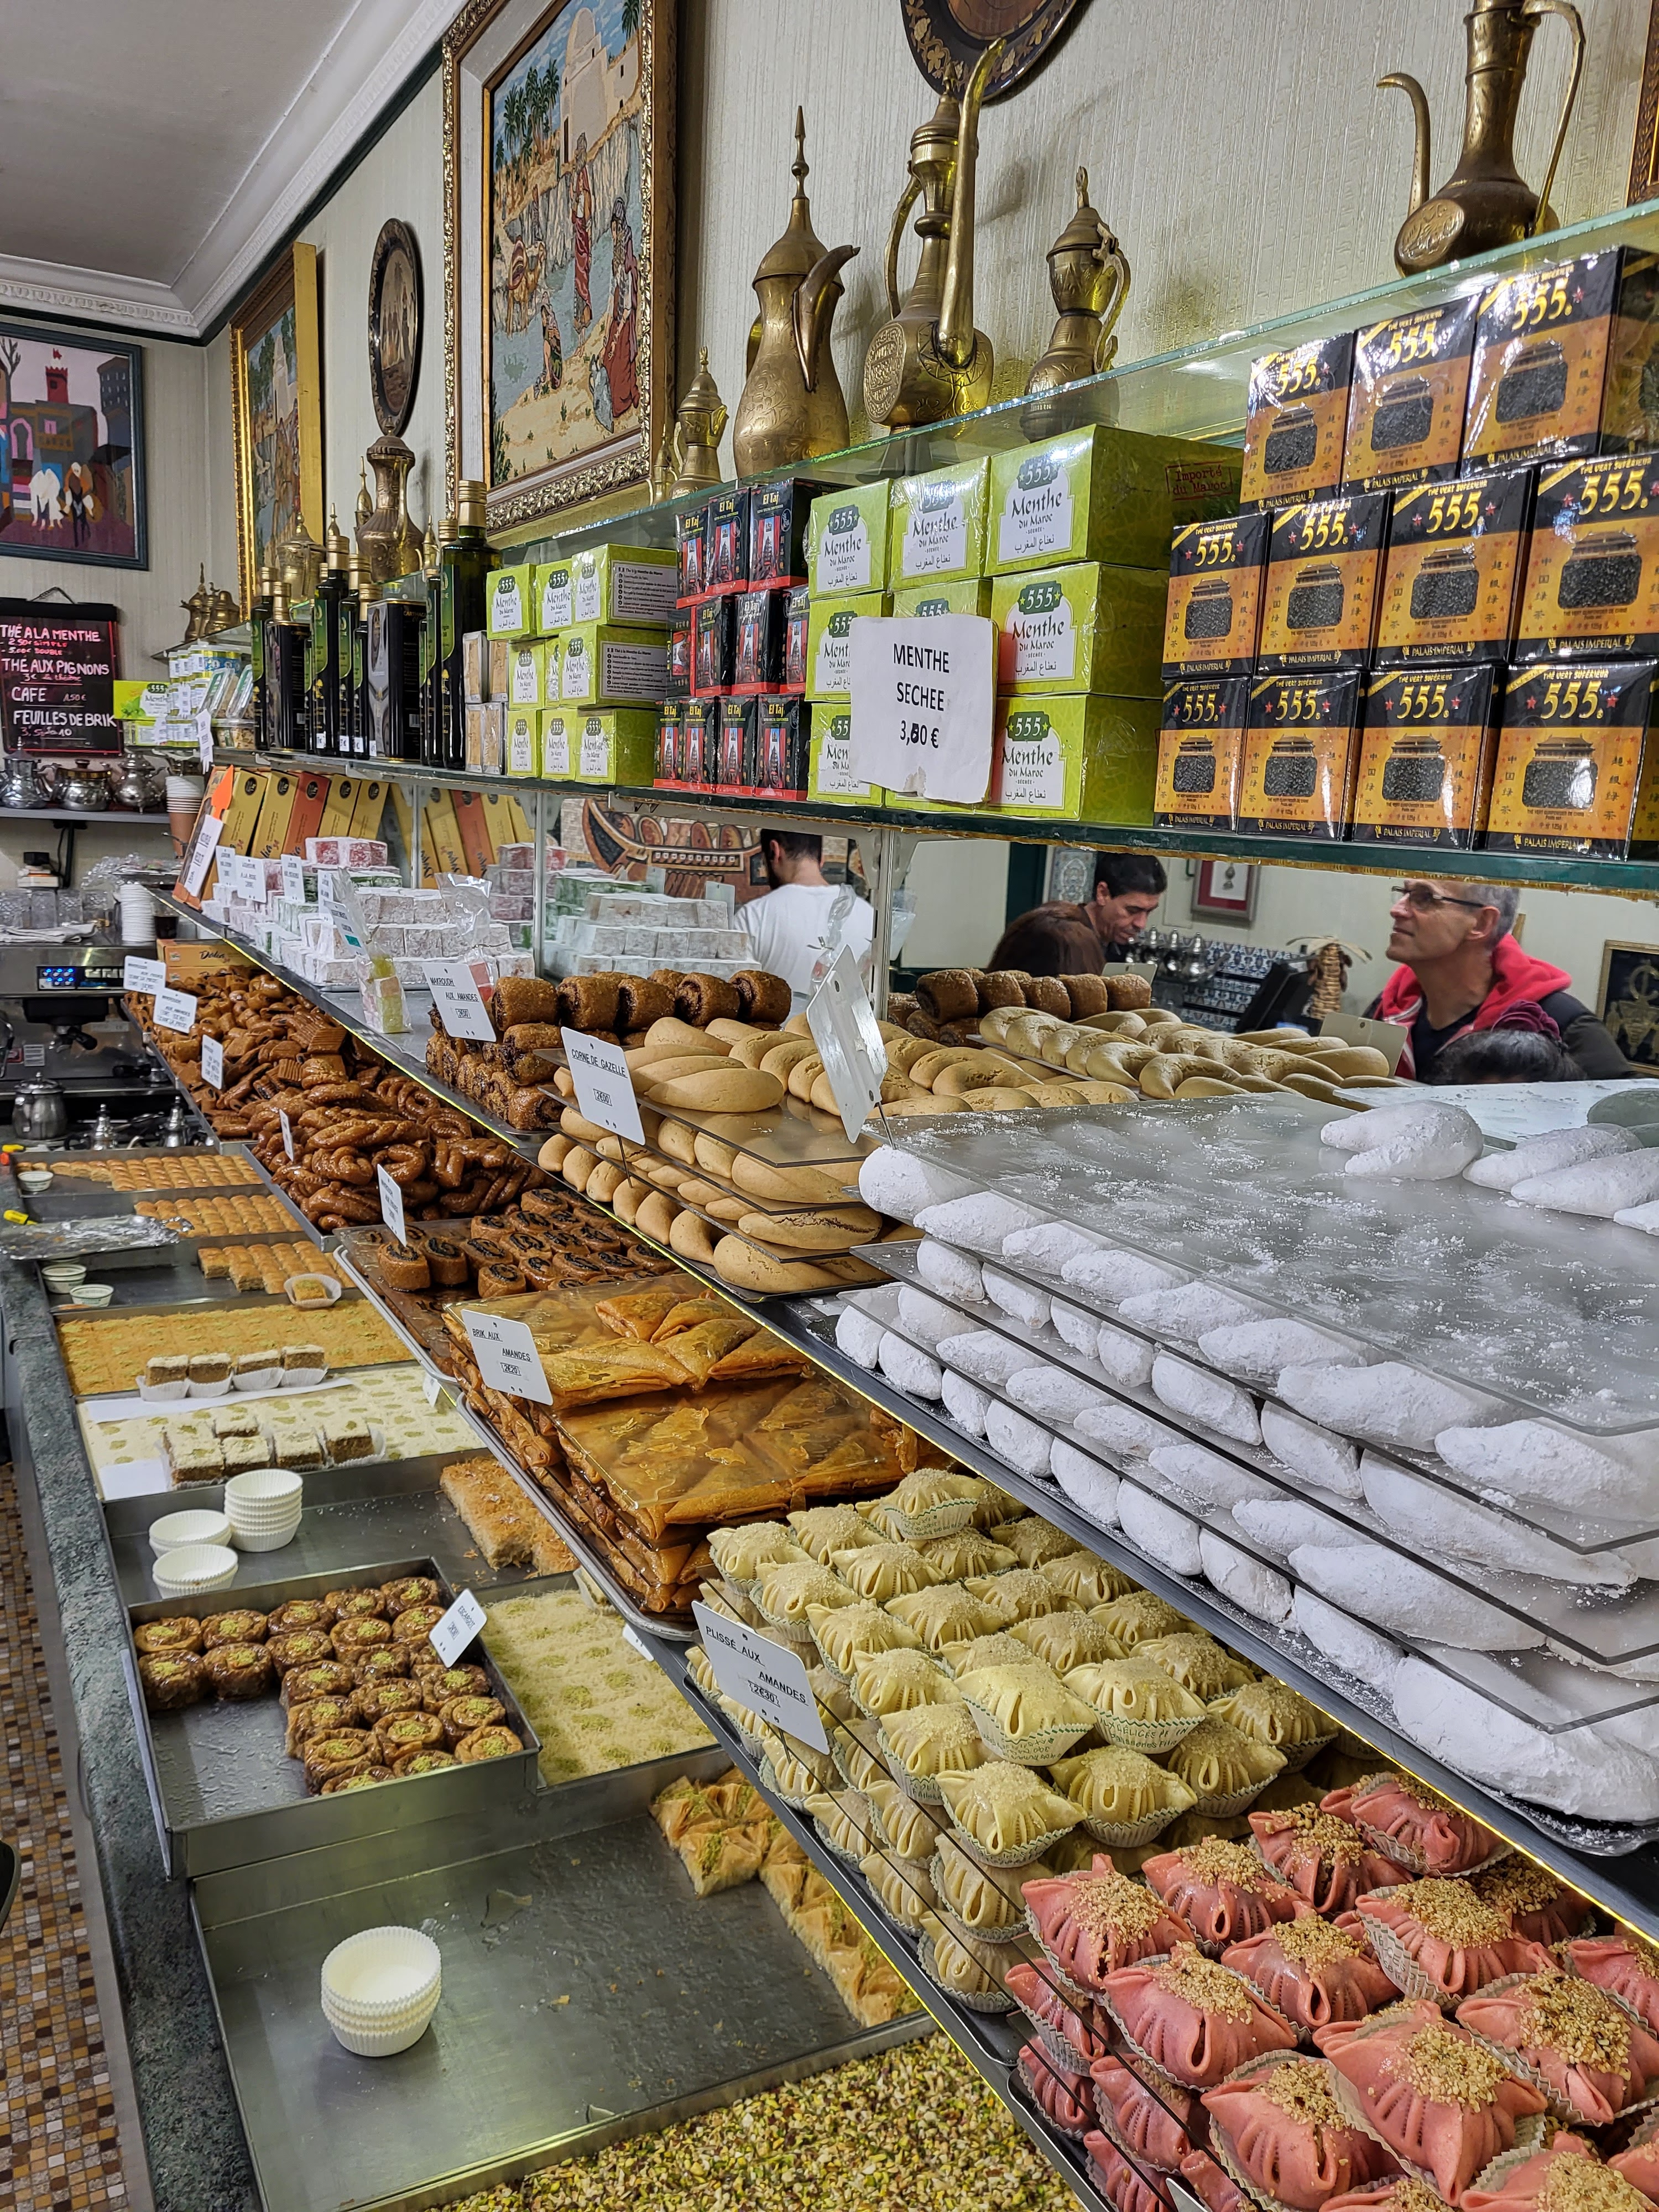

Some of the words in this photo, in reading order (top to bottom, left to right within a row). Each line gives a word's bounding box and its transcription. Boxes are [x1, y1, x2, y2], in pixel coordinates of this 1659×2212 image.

[1512, 277, 1568, 330] 555
[1390, 321, 1436, 365] 555
[1275, 355, 1318, 397] 555
[1025, 462, 1050, 485] 555
[1175, 465, 1222, 482] Importé
[1173, 484, 1187, 495] du
[1192, 481, 1226, 493] Maroc
[1579, 469, 1645, 515] 555
[719, 502, 724, 513] El
[726, 499, 734, 512] Taj
[763, 494, 769, 505] El
[770, 491, 779, 505] Taj
[1011, 487, 1062, 519] Menthe
[833, 510, 853, 530] 555
[1426, 490, 1482, 534] 555
[685, 518, 691, 529] El
[691, 515, 700, 529] Taj
[913, 512, 957, 538] Menthe
[1019, 520, 1027, 529] du
[1030, 514, 1052, 526] Maroc
[1300, 512, 1347, 550] 555
[825, 534, 862, 557] Menthe
[928, 536, 948, 546] Maroc
[1194, 531, 1234, 566] 555
[838, 555, 855, 564] Maroc
[500, 578, 512, 591] 555
[553, 572, 565, 586] 555
[496, 594, 517, 608] Menthe
[547, 589, 570, 604] Menthe
[1026, 587, 1053, 609] 555
[52, 629, 101, 641] MENTHE
[1013, 615, 1064, 640] Menthe
[824, 640, 849, 659] Ment
[1020, 643, 1028, 651] du
[1030, 640, 1054, 650] Maroc
[1586, 638, 1622, 649] IMPERIAL
[893, 643, 950, 674] MENTHE
[1411, 647, 1433, 657] PALAIS
[30, 659, 54, 673] AUX
[56, 660, 109, 675] PIGNONS
[517, 667, 534, 680] Menthe
[12, 686, 47, 702] CAFE
[896, 681, 945, 712] SECHEE
[1397, 684, 1447, 719] 555
[1540, 680, 1601, 719] 555
[664, 706, 669, 715] El
[689, 706, 695, 715] El
[728, 705, 733, 714] El
[768, 704, 774, 714] El
[775, 704, 784, 717] Taj
[1182, 693, 1217, 722] 555
[1275, 688, 1318, 721] 555
[13, 710, 67, 725] FEUILLES
[69, 713, 83, 726] DE
[85, 713, 117, 727] BRIK
[1015, 717, 1041, 736] 555
[1002, 744, 1053, 765] Menthe
[1009, 768, 1017, 777] du
[1020, 767, 1044, 777] Maroc
[1266, 821, 1282, 830] PALAIS
[1383, 828, 1402, 837] PALAIS
[1404, 828, 1431, 838] IMPERIAL
[1524, 837, 1547, 848] PALAIS
[430, 977, 455, 986] MAKROUDH
[457, 992, 478, 1001] AMANDES
[571, 1049, 589, 1063] CORNE
[591, 1056, 598, 1066] DE
[601, 1059, 626, 1076] GAZELLE
[597, 1092, 609, 1103] 2€00
[472, 1328, 486, 1338] BRIK
[488, 1332, 500, 1340] AUX
[502, 1348, 531, 1361] AMANDES
[504, 1364, 518, 1374] 2€20
[706, 1626, 737, 1650] PLISSÉ
[742, 1646, 762, 1663] AUX
[754, 1684, 775, 1703] 2€30
[758, 1671, 806, 1704] AMANDES
